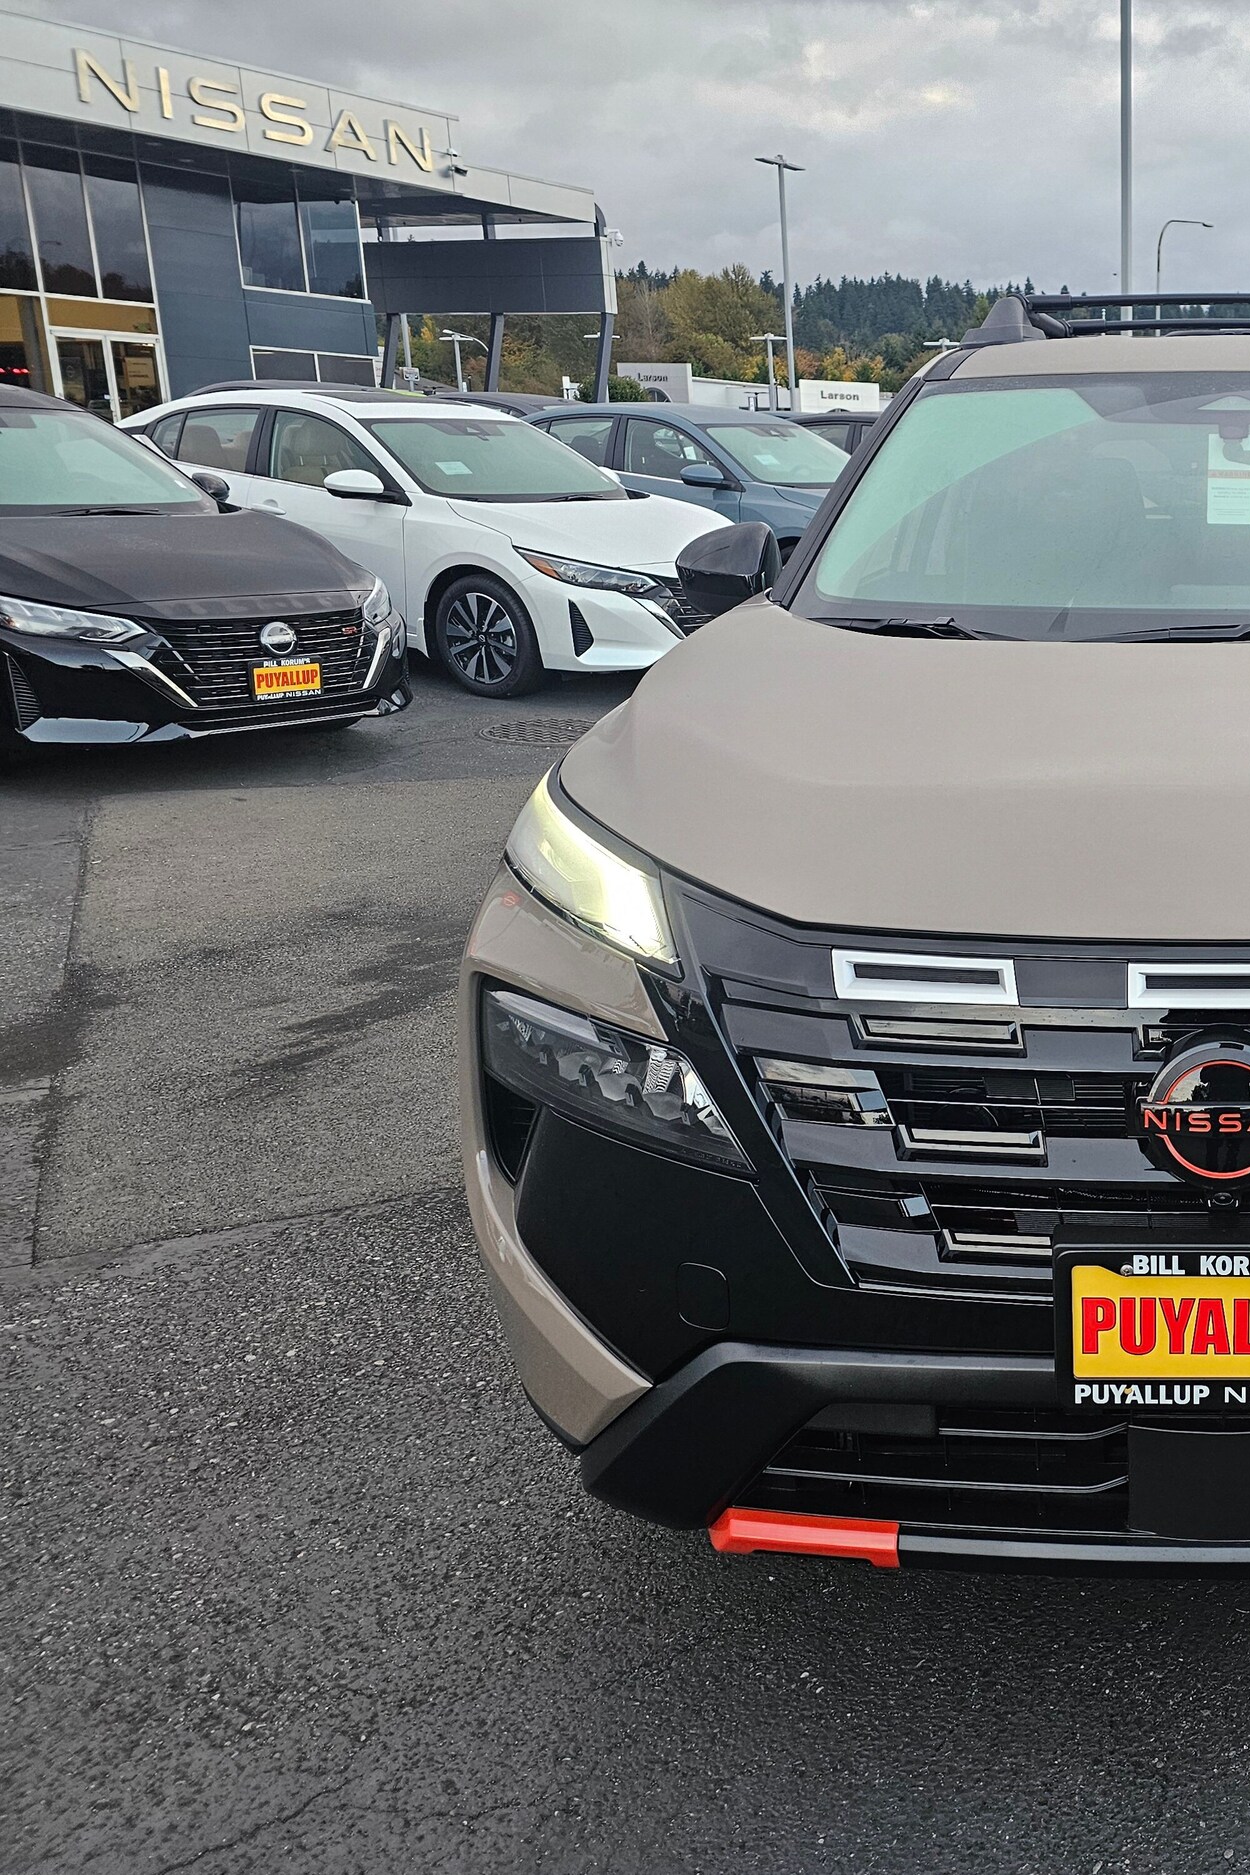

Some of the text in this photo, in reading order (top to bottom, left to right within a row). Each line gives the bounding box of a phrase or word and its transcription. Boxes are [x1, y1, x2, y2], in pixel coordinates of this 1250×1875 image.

[72, 47, 434, 172] NISSAN
[637, 372, 669, 382] Larson
[820, 390, 860, 401] Larson
[263, 660, 279, 668] BILL
[256, 669, 318, 689] PUYALLUP
[285, 688, 322, 698] NISSAN
[1132, 1254, 1185, 1275] BILL
[1074, 1383, 1210, 1405] PUYALLUP
